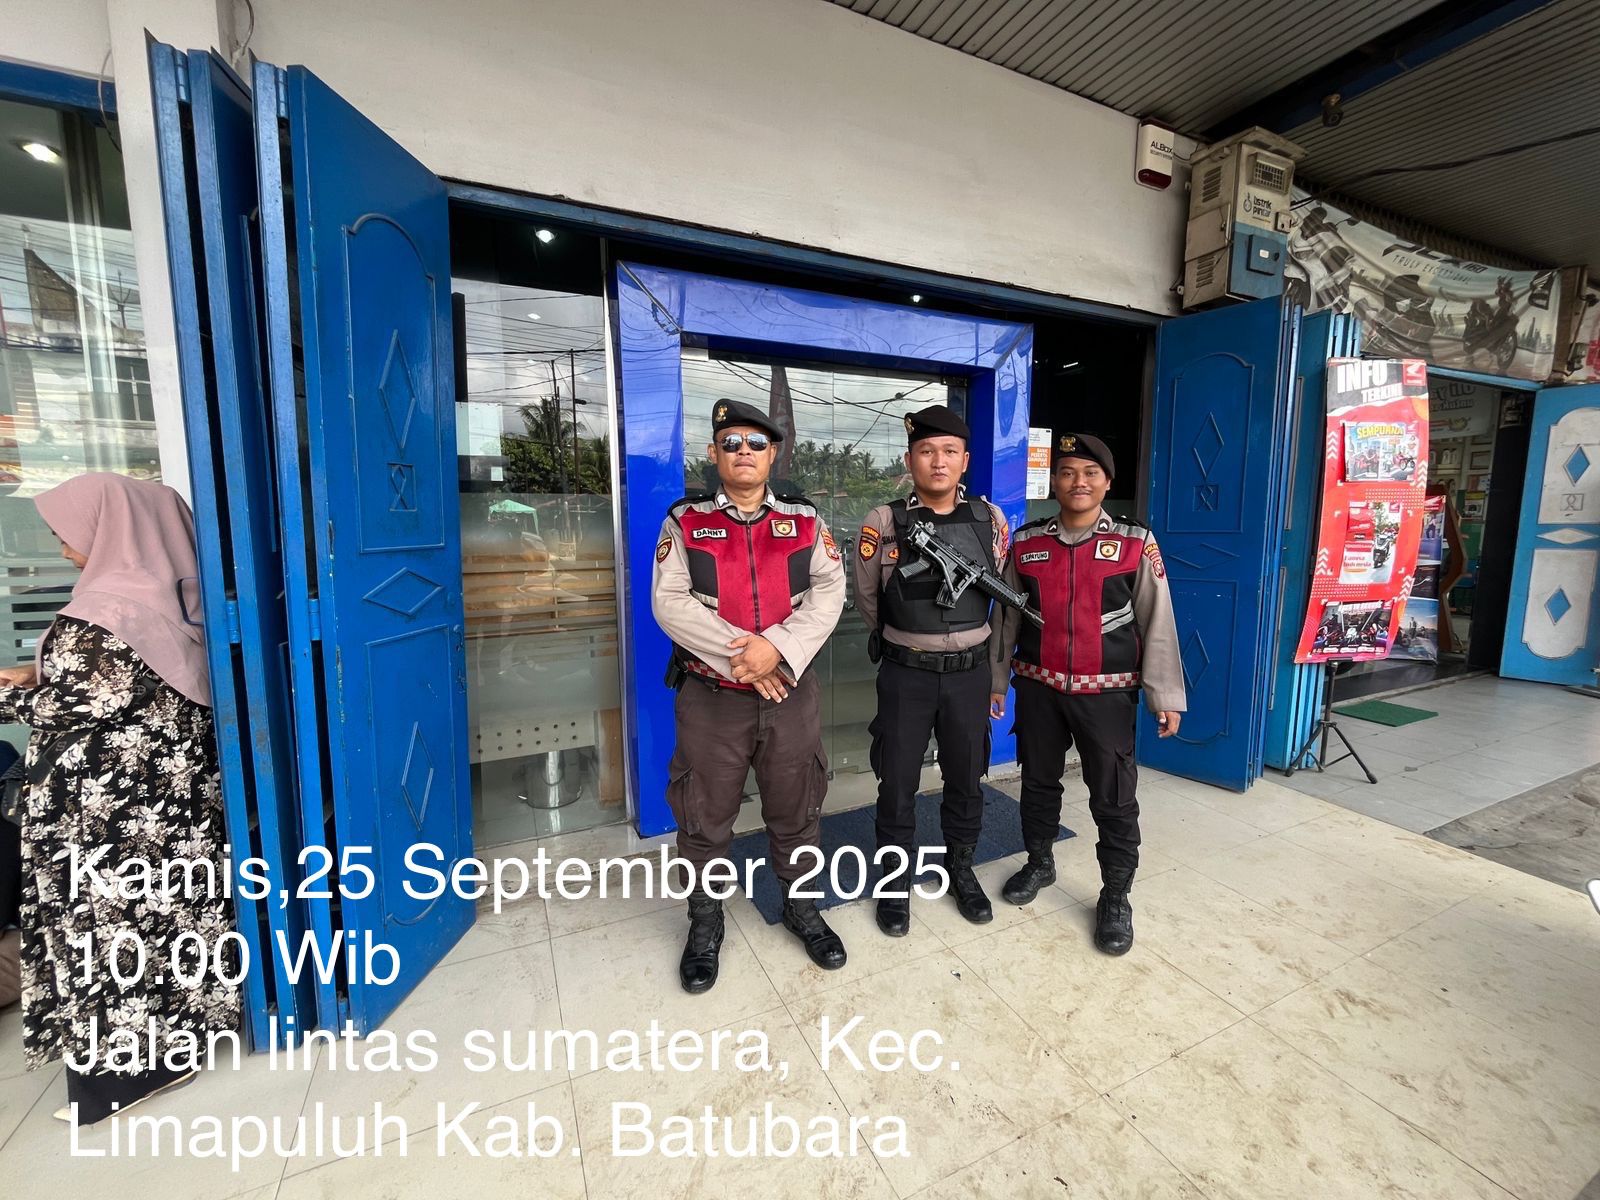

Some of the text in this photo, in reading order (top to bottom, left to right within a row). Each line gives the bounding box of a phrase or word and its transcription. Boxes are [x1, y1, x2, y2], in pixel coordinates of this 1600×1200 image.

[1150, 140, 1173, 154] ALBOX
[1393, 254, 1420, 269] TRULY
[1337, 360, 1388, 394] INFO
[696, 528, 723, 537] DANNY
